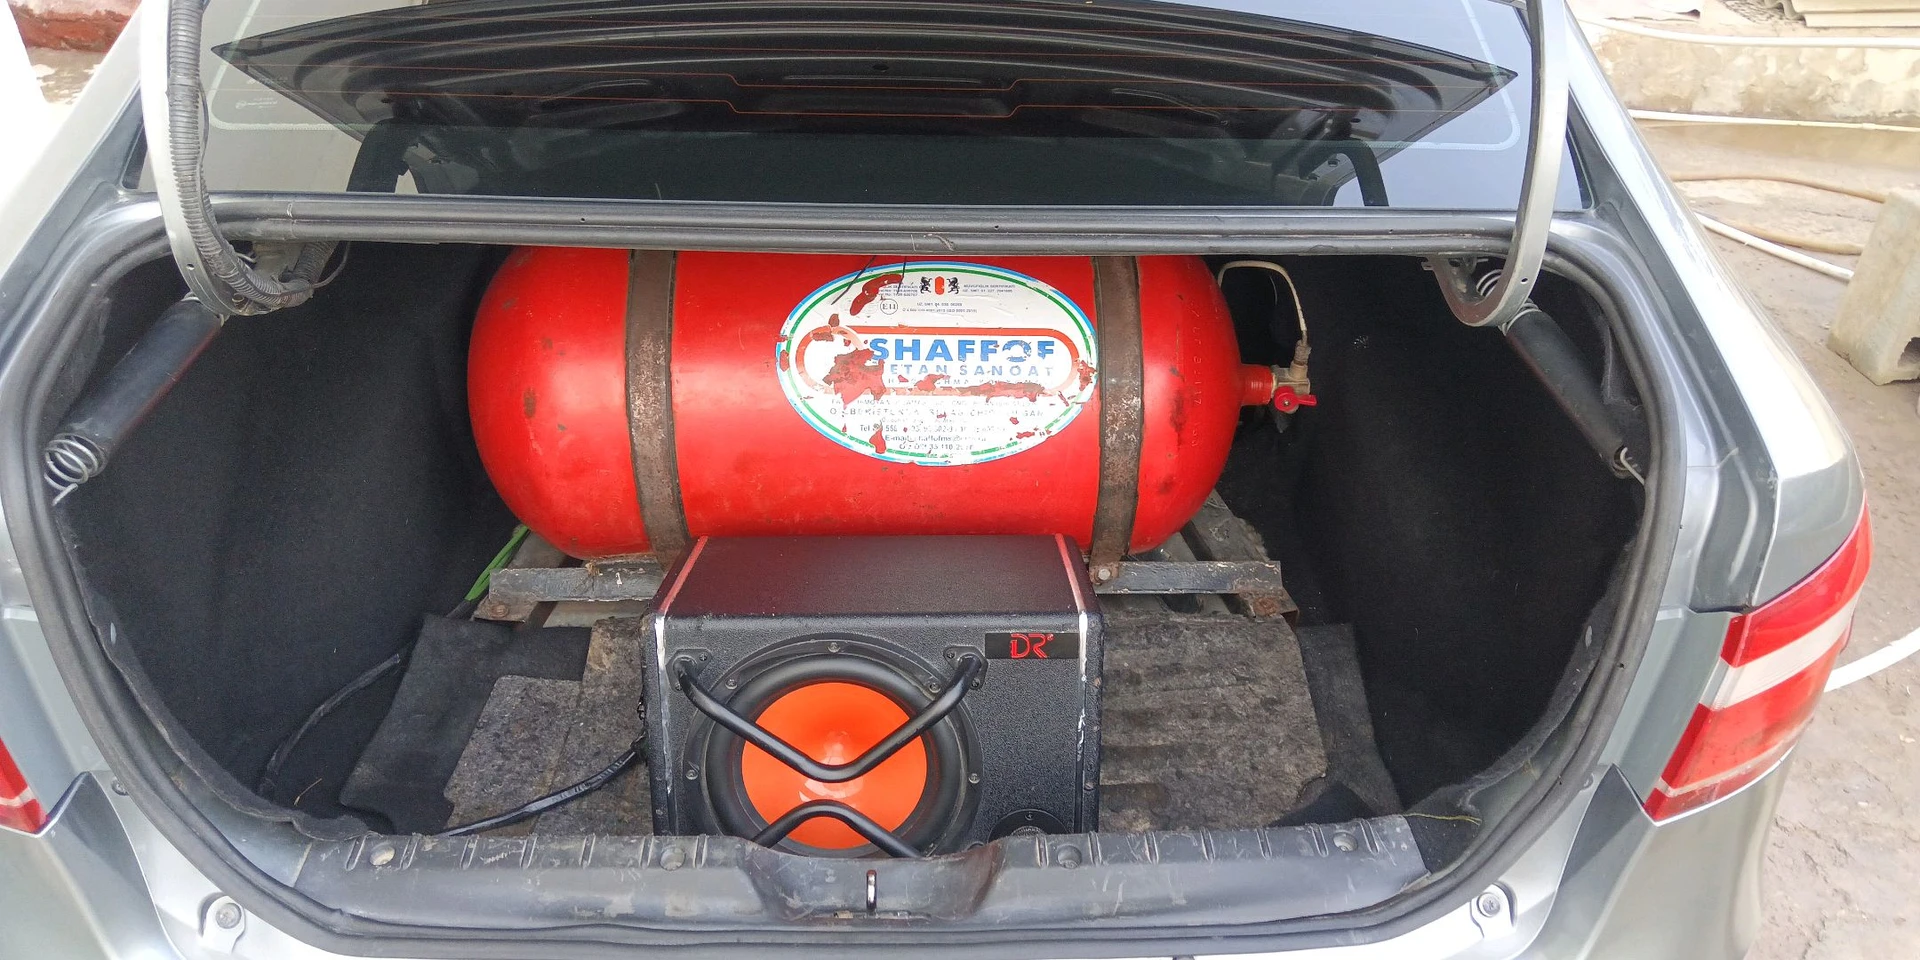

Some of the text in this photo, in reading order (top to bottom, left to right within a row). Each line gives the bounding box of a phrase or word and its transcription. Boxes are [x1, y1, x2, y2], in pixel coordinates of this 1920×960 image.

[869, 338, 1055, 362] SHAFFOF
[889, 363, 1054, 377] ETAN SANOAT
